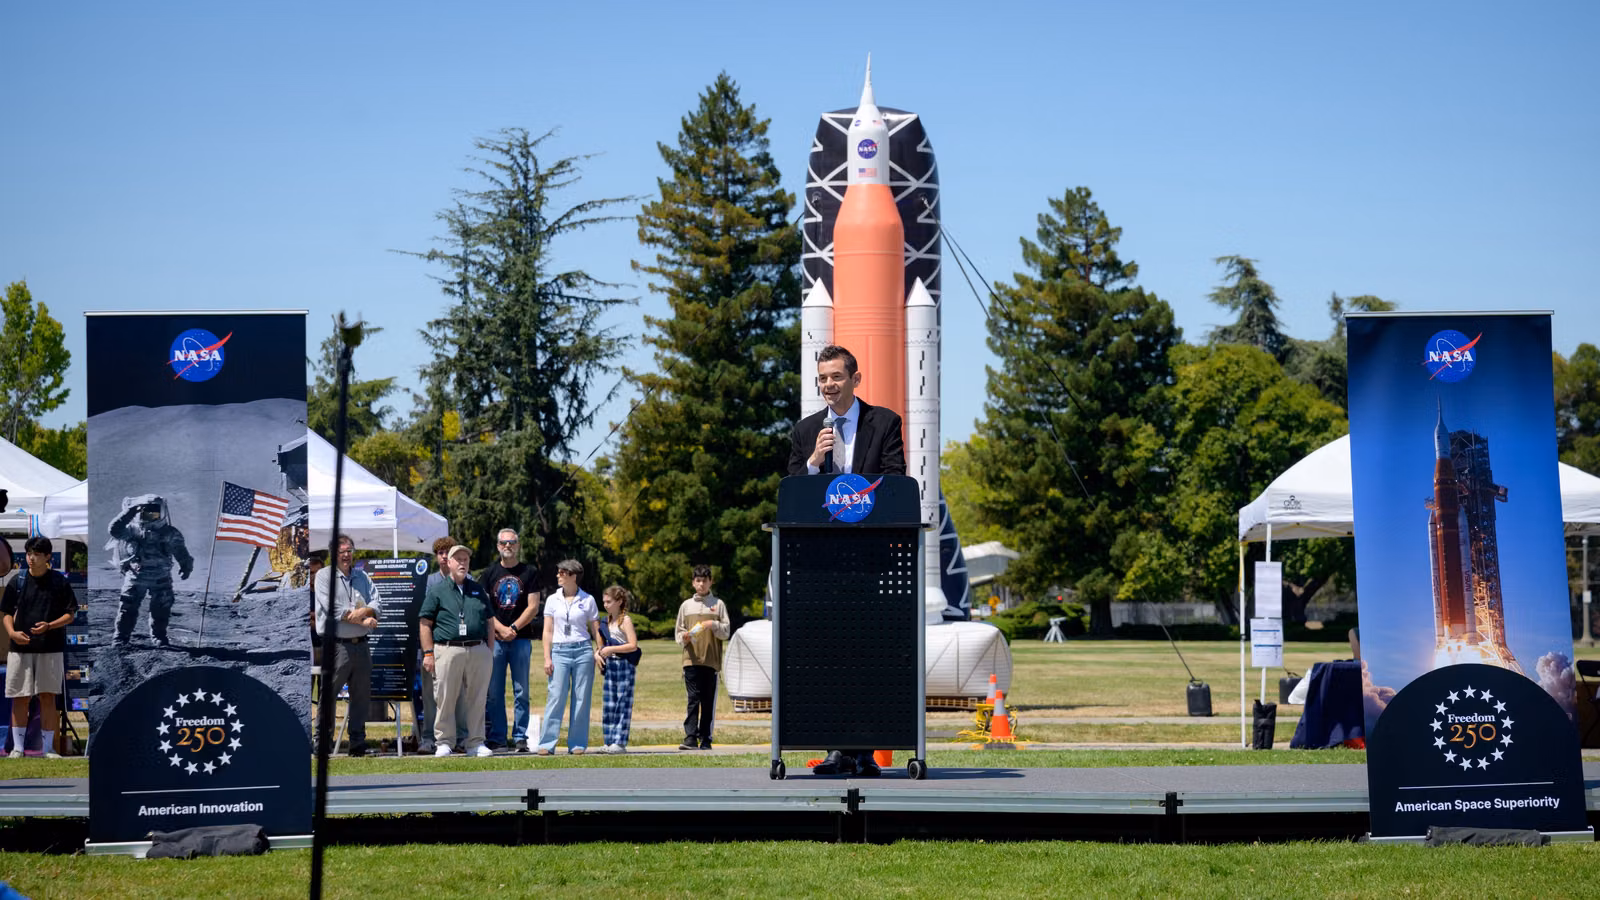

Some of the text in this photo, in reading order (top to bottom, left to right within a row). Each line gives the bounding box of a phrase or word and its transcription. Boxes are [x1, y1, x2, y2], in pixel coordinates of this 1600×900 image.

[174, 350, 222, 361] NASA
[1429, 351, 1474, 362] NASA
[829, 494, 873, 505] NASA
[1464, 570, 1472, 592] NASA
[175, 716, 225, 727] Freedom
[1447, 712, 1496, 724] Freedom
[176, 727, 225, 752] 250
[1450, 723, 1497, 749] 250
[138, 801, 264, 816] American Innovation
[1395, 796, 1560, 812] American Space Superiority
